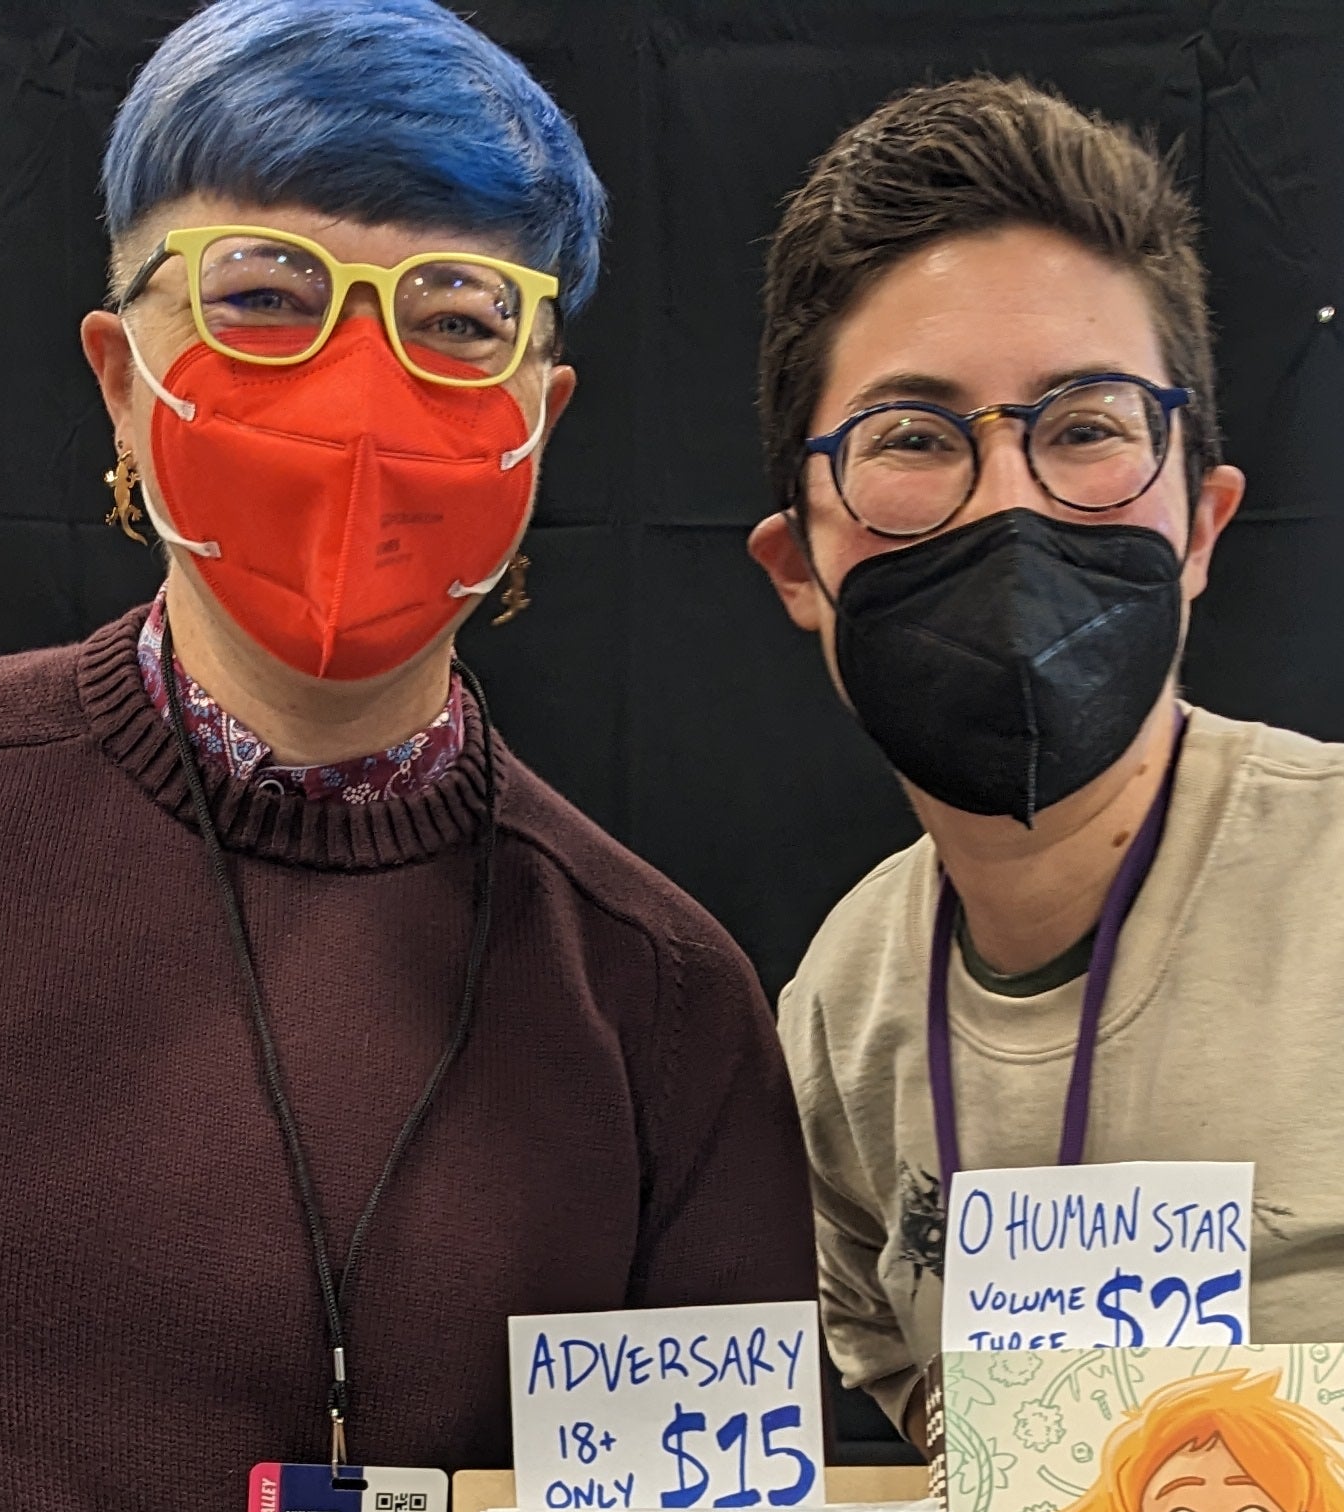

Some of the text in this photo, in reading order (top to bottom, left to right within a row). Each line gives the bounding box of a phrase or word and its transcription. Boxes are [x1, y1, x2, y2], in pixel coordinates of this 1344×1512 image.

[958, 1186, 1248, 1261] O HUMAN STAR
[968, 1283, 1086, 1316] VOLUME
[528, 1329, 807, 1396] ADVERSARY
[557, 1402, 818, 1509] 18+ $15
[545, 1473, 635, 1508] ONLY
